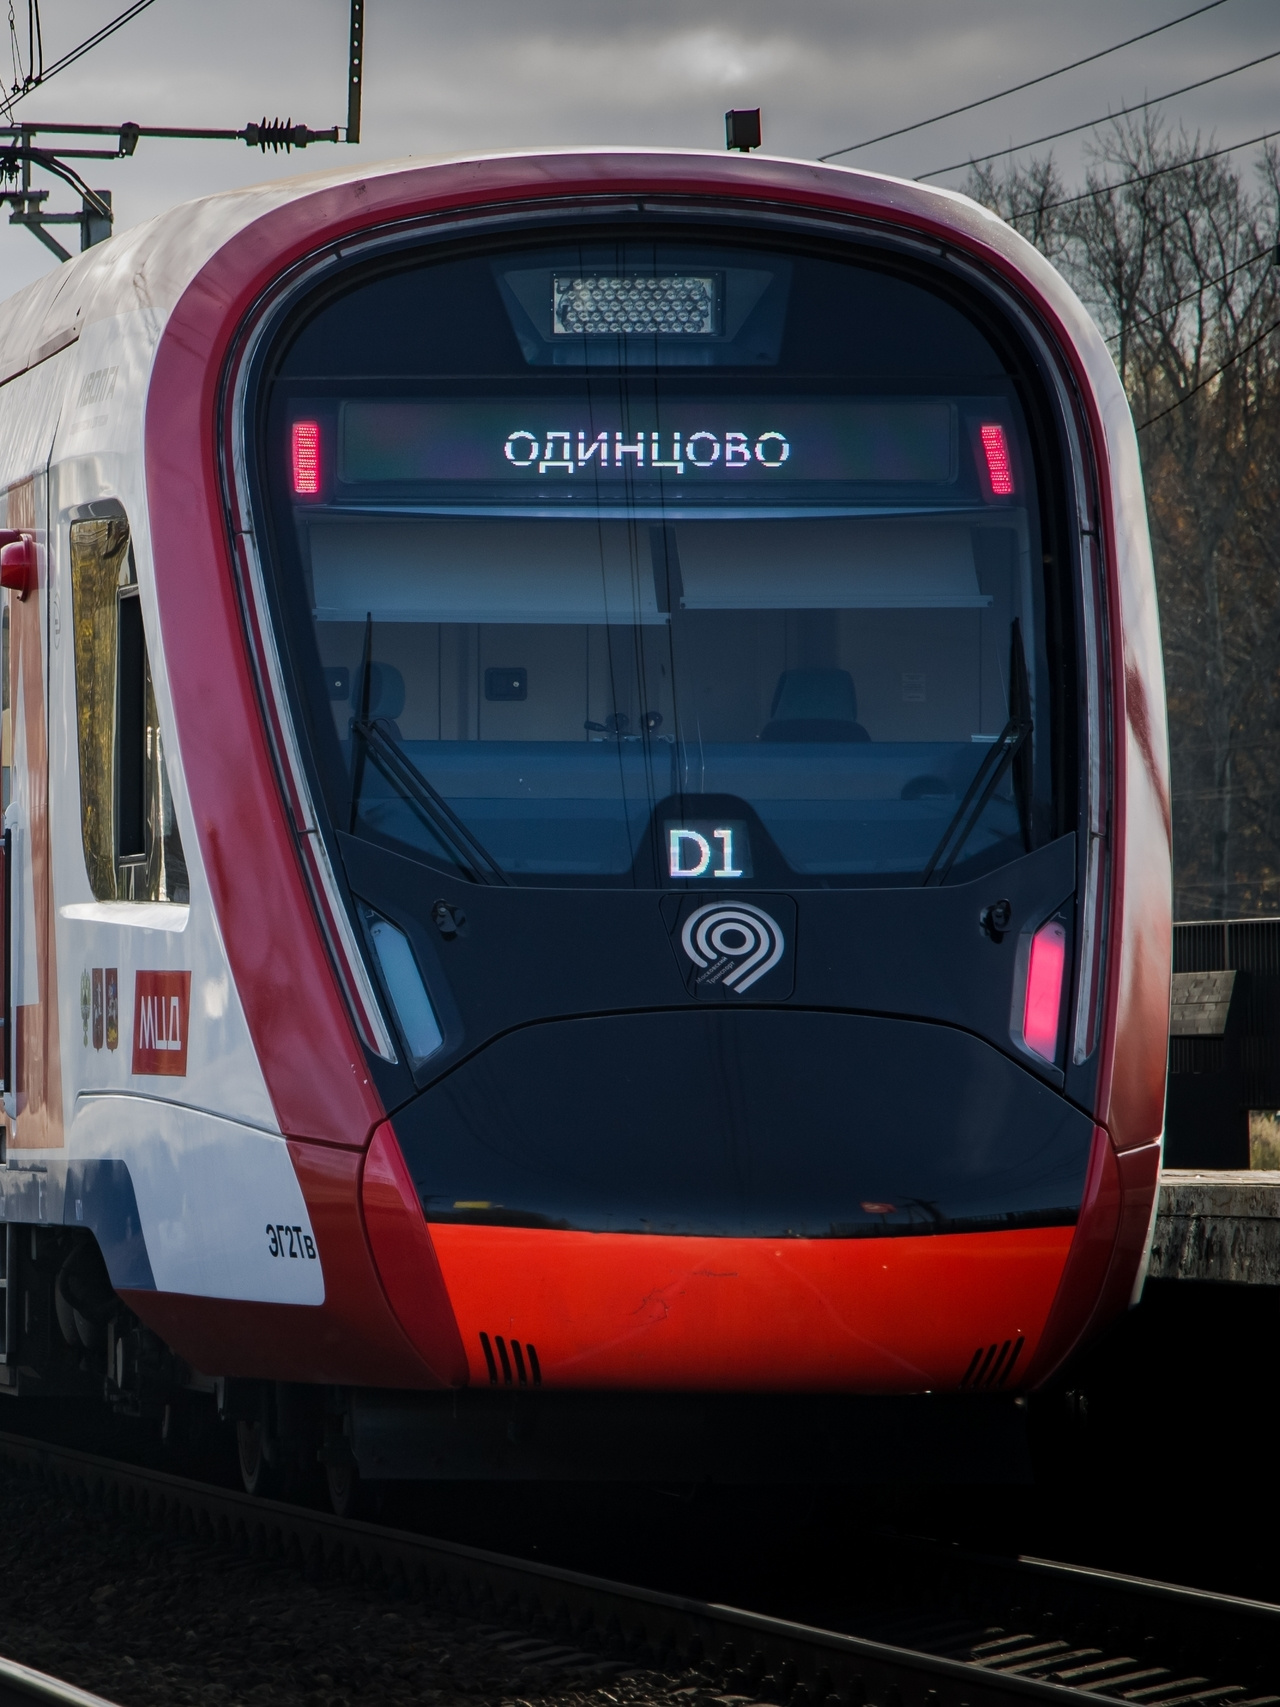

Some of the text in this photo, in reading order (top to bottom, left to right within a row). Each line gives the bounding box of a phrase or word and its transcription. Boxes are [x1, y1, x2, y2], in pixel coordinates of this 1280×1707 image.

[504, 430, 790, 474] ОДИНЦОВО
[669, 829, 743, 877] D1
[139, 995, 182, 1050] МЦД
